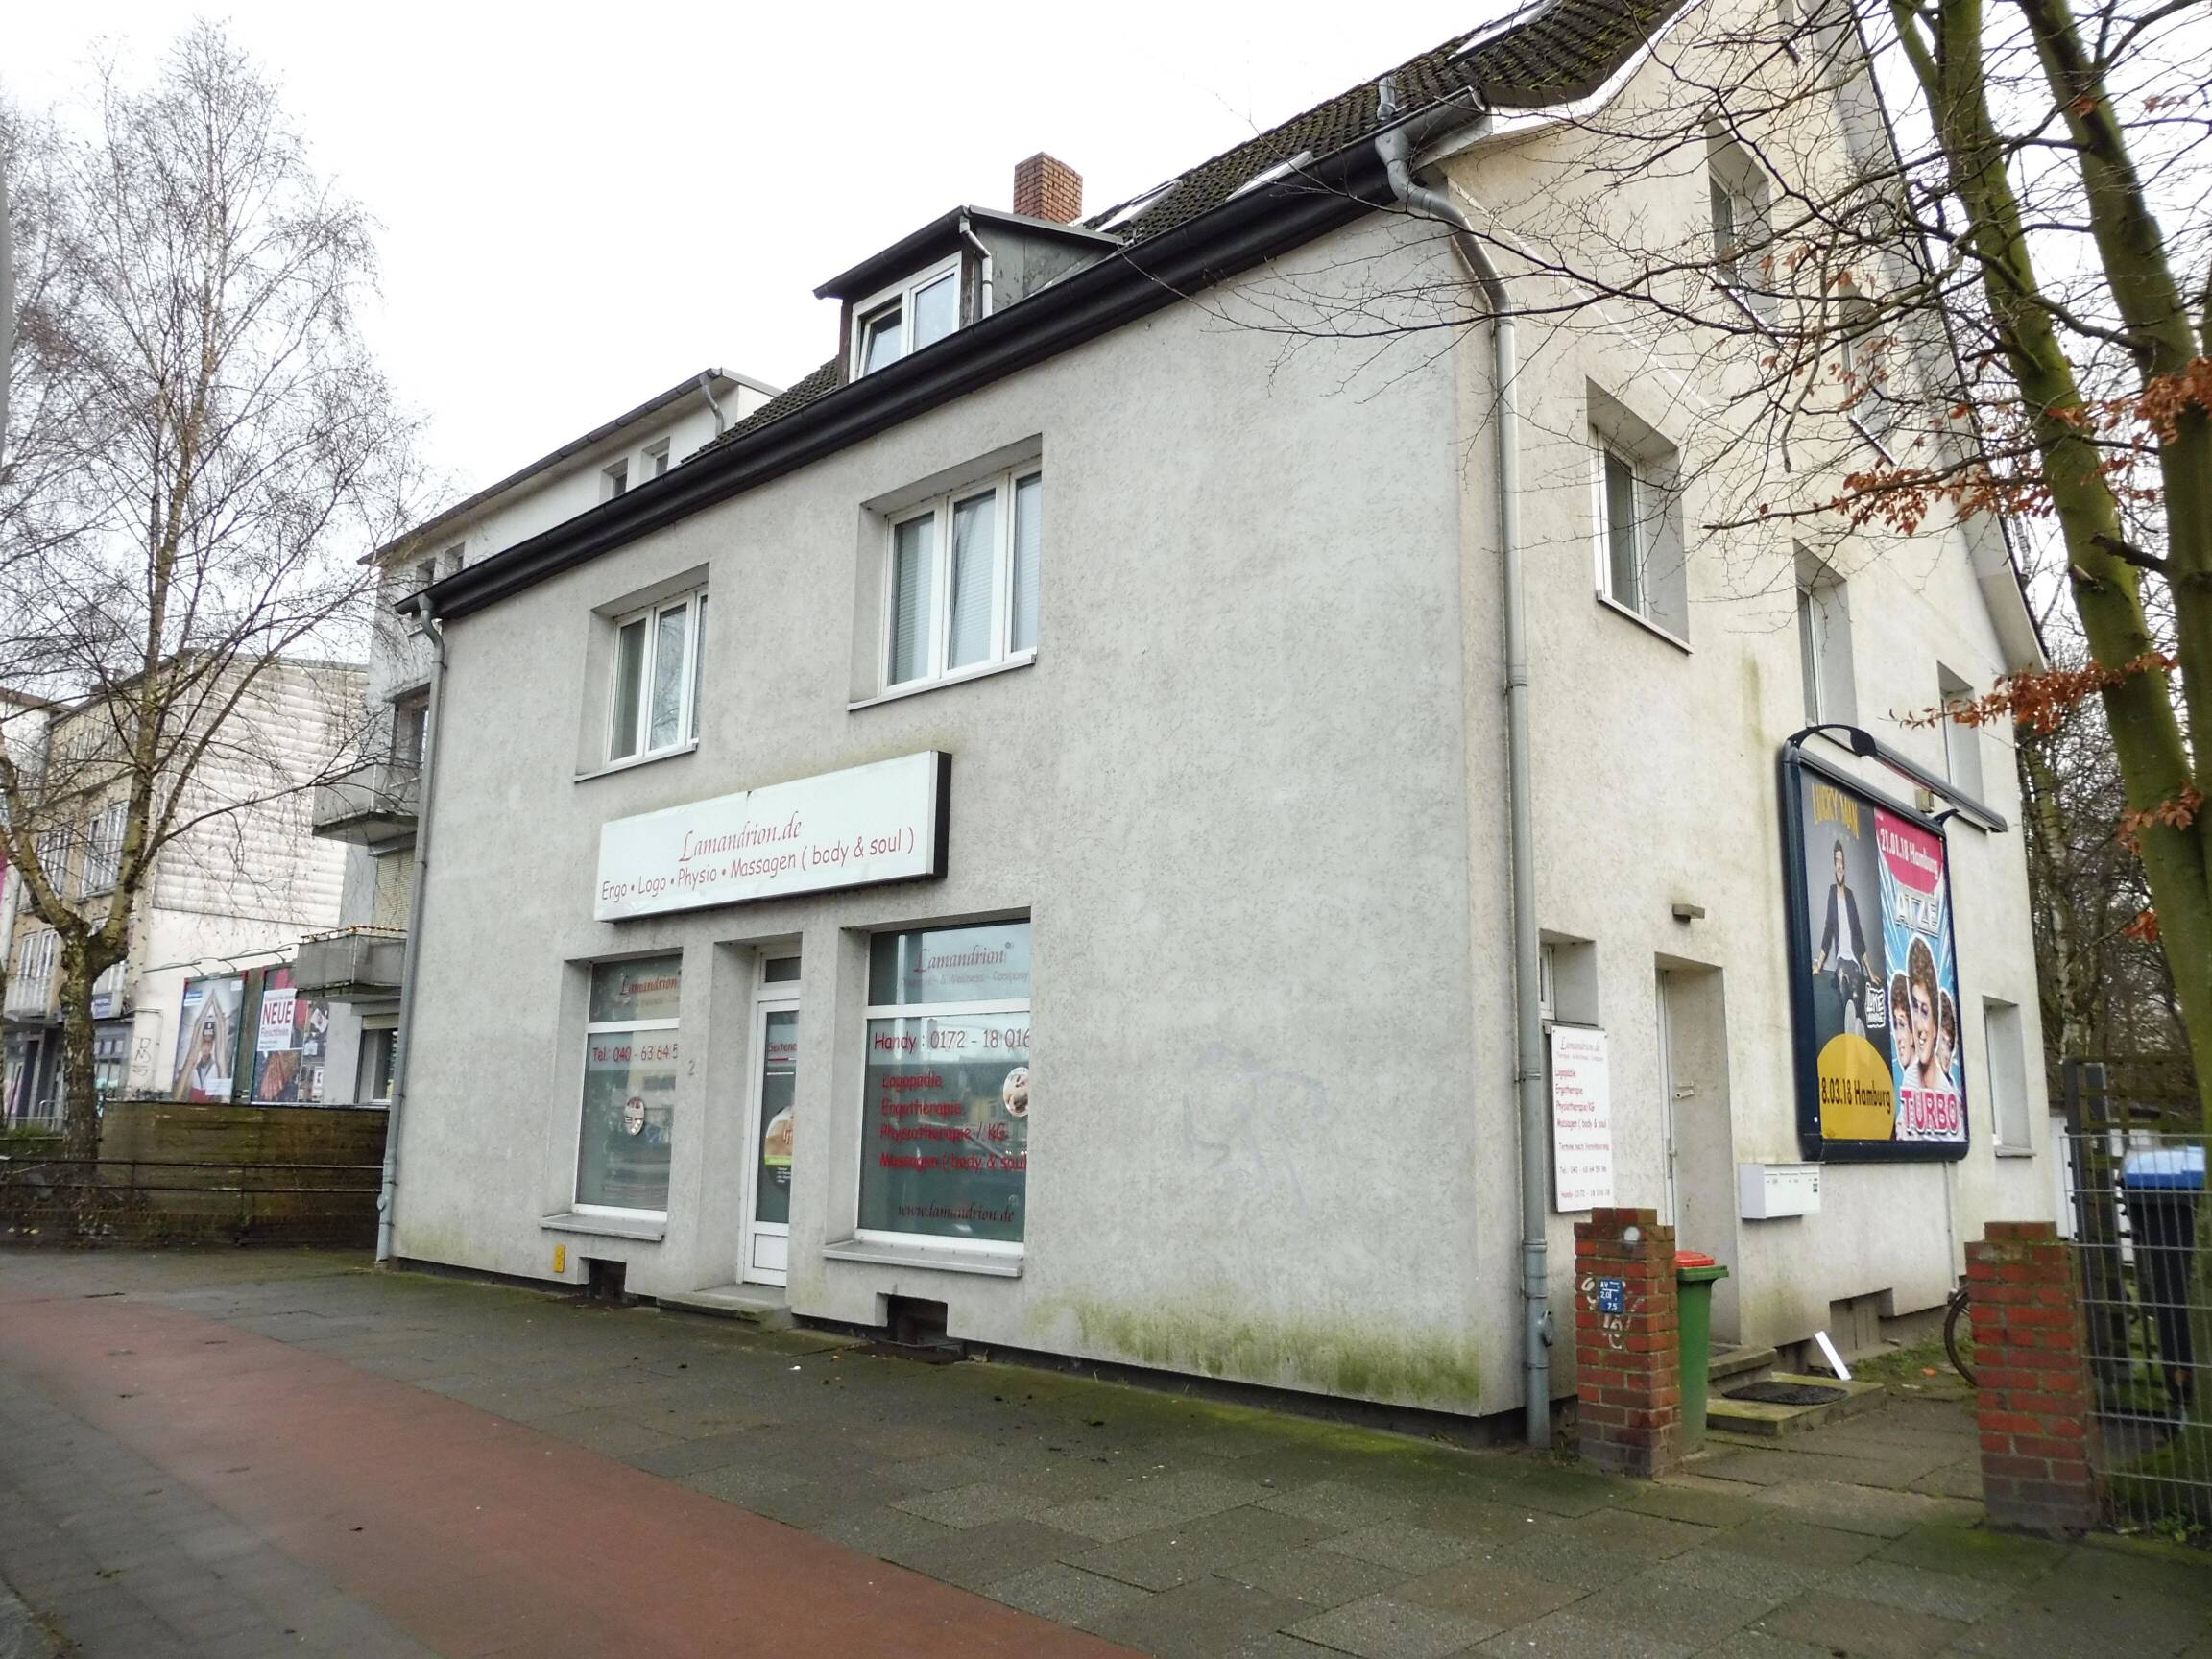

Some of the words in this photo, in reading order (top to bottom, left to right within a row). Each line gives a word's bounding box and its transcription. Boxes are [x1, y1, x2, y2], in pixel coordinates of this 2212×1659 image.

[679, 810, 802, 862] Lamandrion.de
[1880, 828, 1909, 862] 21.01.18
[1910, 842, 1939, 881] Hamburg
[602, 880, 628, 903] Ergo
[637, 876, 666, 898] Logo
[677, 864, 717, 891] Physio
[731, 853, 796, 878] Massagen
[813, 839, 849, 867] body
[854, 836, 863, 858] &
[870, 829, 902, 855] soul
[262, 1000, 293, 1025] NEUE
[641, 1045, 654, 1061] 63
[930, 1030, 966, 1049] 0172
[983, 1029, 999, 1049] 18
[1854, 1079, 1891, 1115] Hamburg
[1901, 1089, 1960, 1132] TURBO
